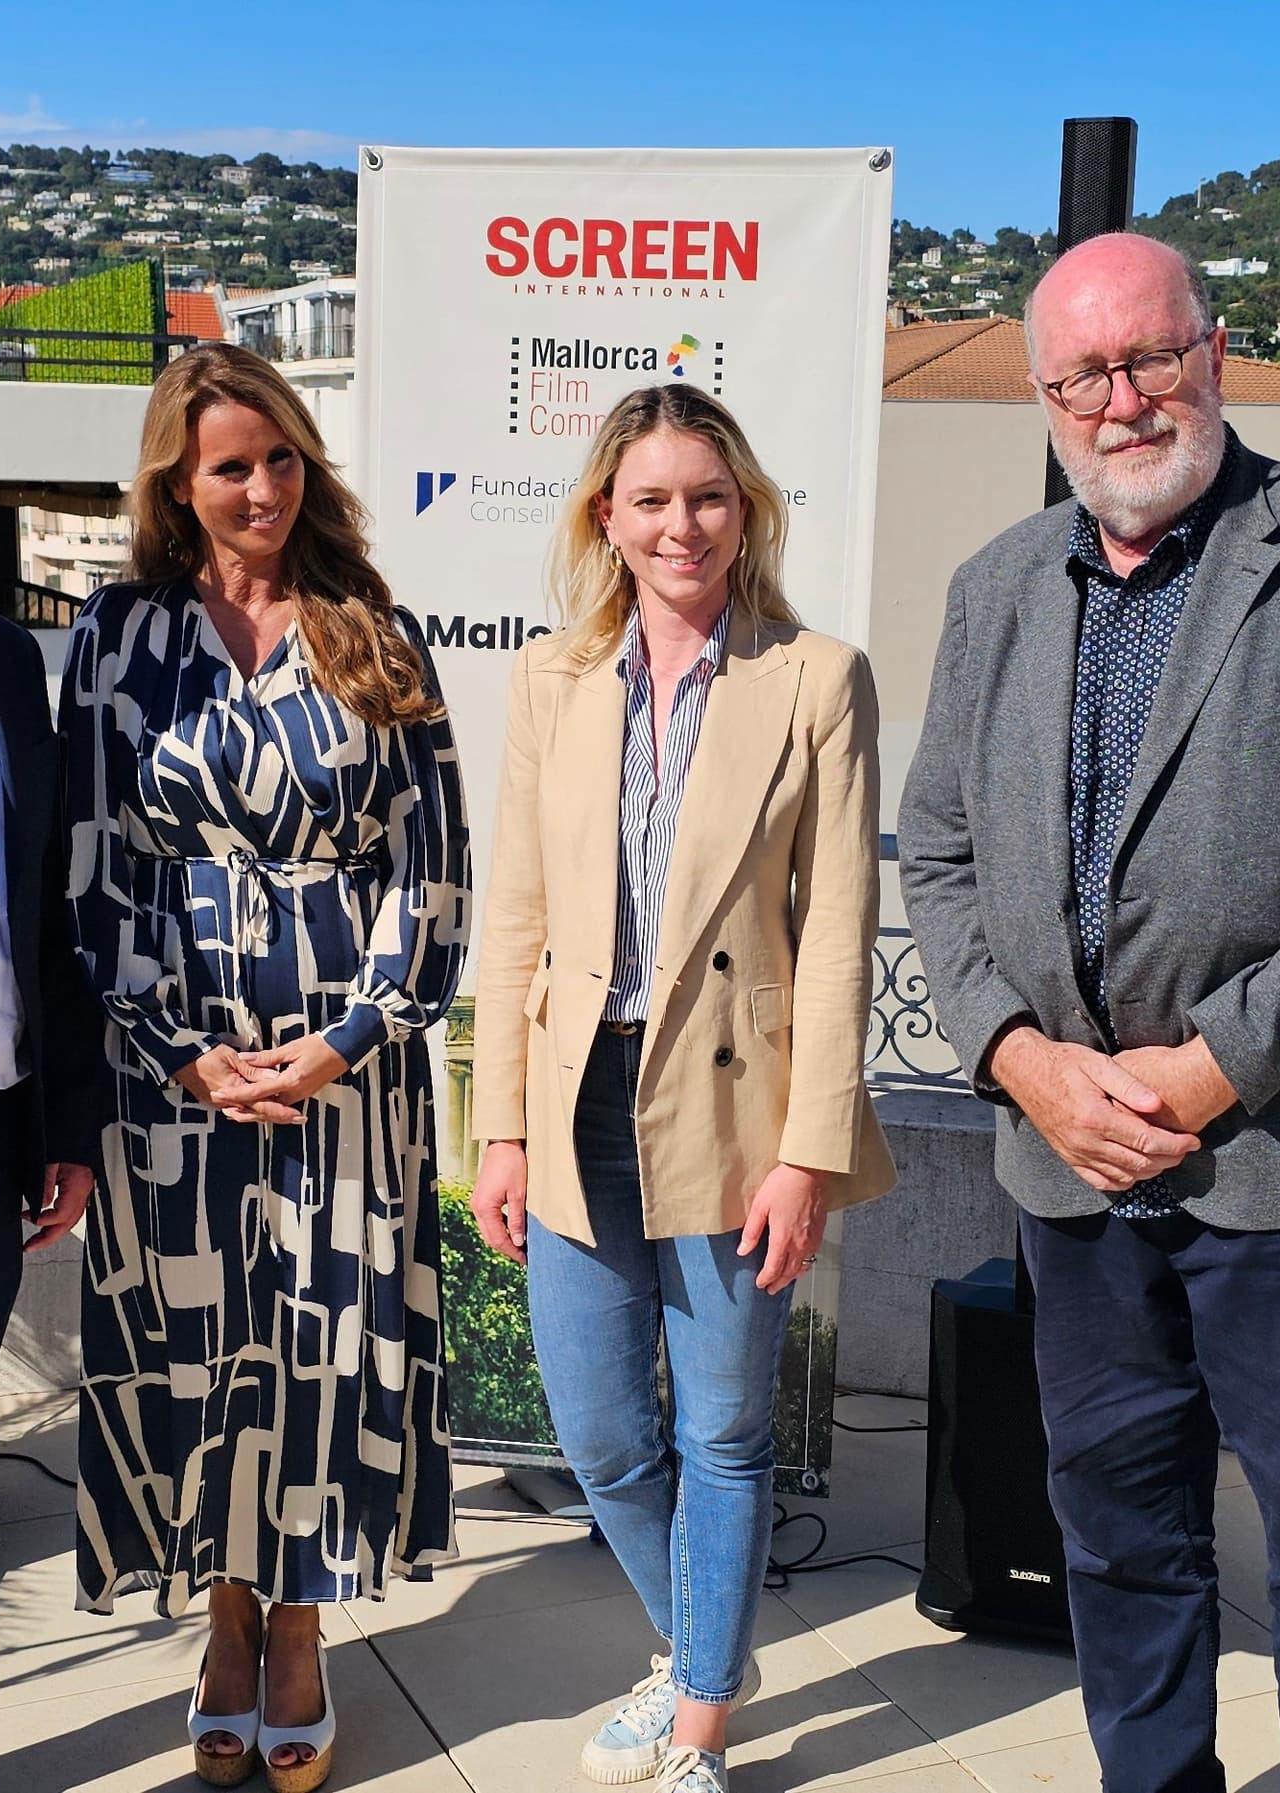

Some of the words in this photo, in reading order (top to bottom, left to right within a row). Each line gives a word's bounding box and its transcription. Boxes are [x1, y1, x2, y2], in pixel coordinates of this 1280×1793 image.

[486, 216, 759, 281] SCREEN
[514, 284, 725, 299] INTERNATIONAL
[531, 337, 657, 371] Mallorca
[530, 371, 588, 402] Film
[470, 501, 555, 523] Consell
